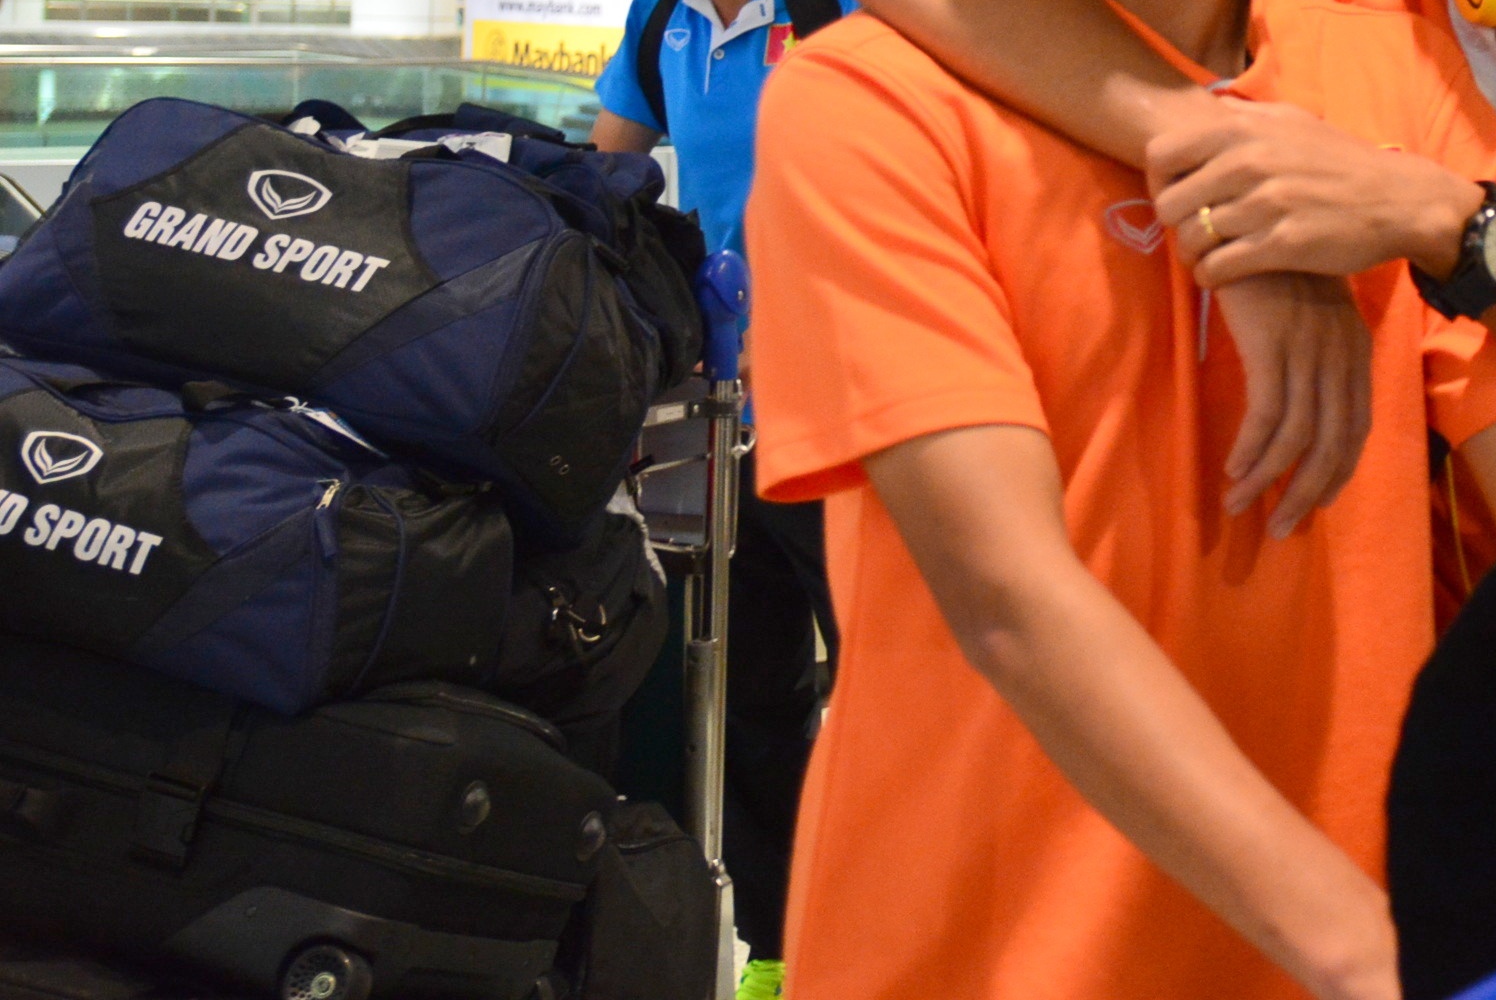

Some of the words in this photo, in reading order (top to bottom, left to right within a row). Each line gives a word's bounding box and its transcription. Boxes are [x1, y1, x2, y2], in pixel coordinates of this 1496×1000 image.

[123, 200, 259, 262] GRAND
[252, 233, 391, 292] SPORT
[23, 503, 164, 576] SPORT
